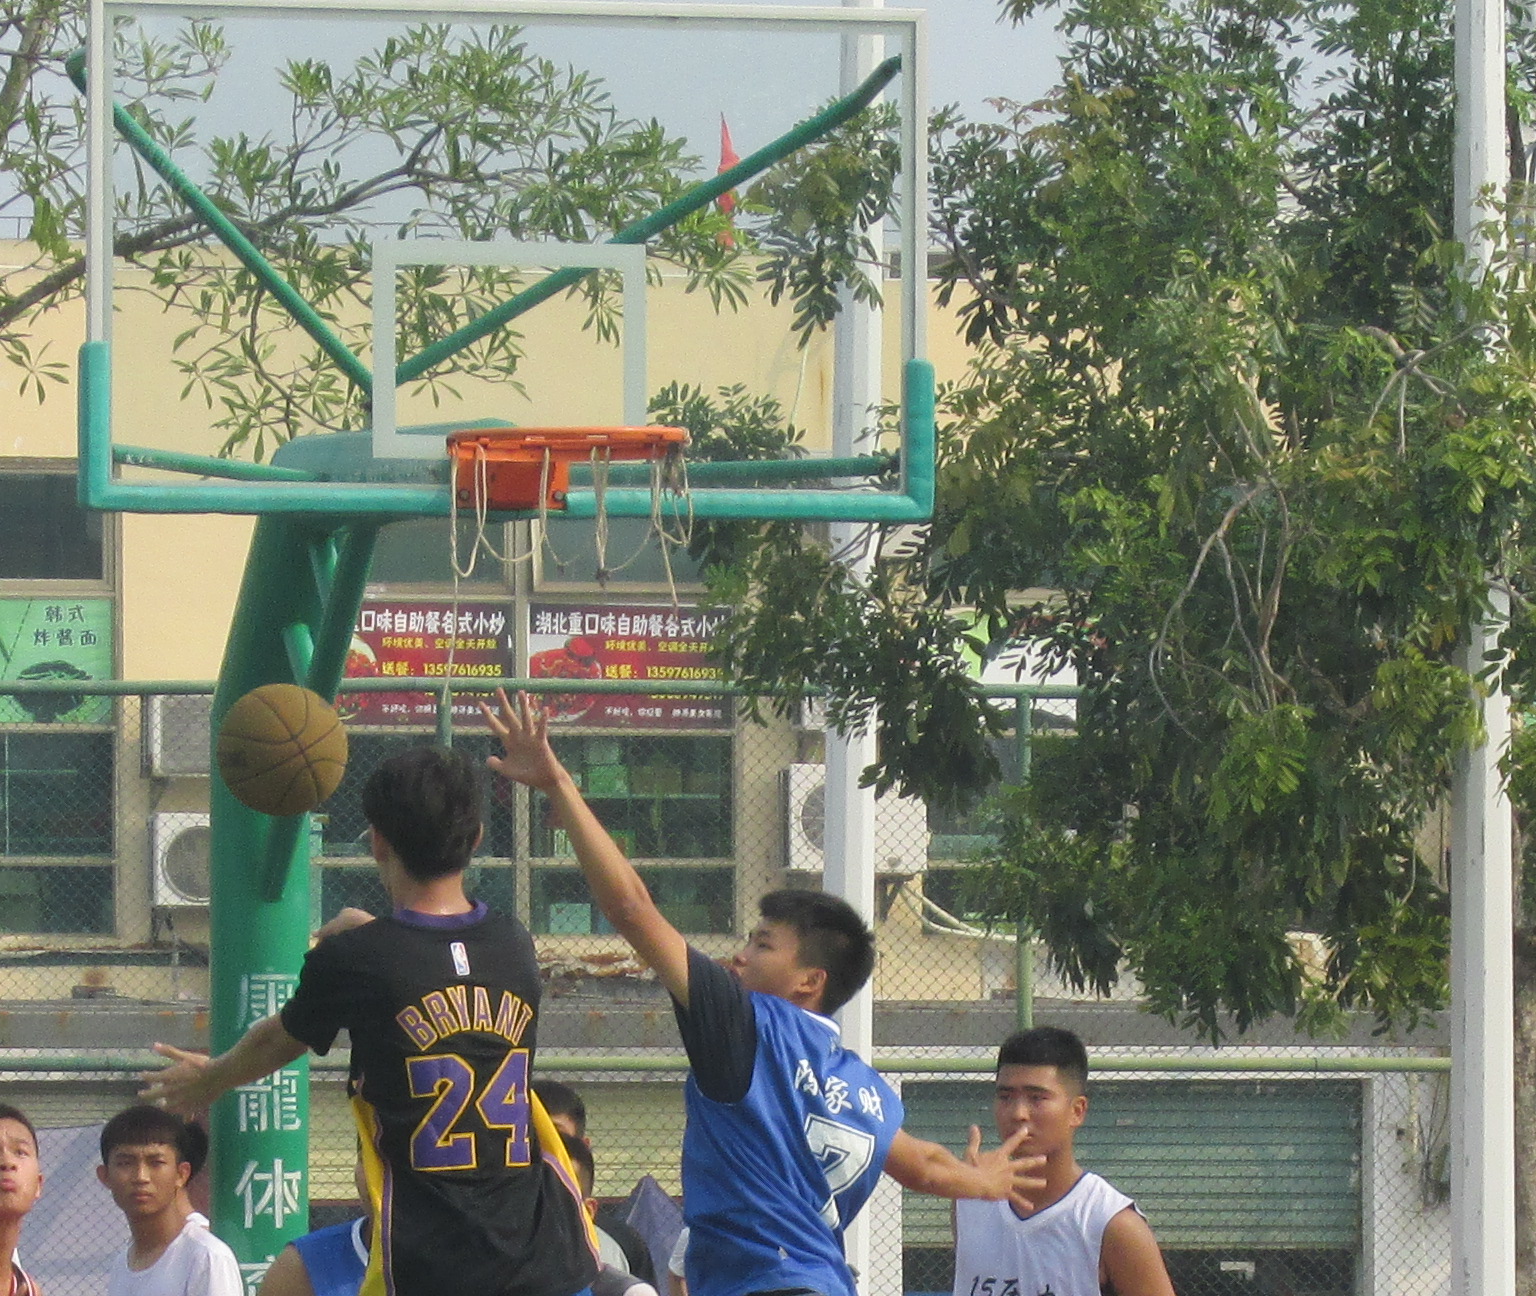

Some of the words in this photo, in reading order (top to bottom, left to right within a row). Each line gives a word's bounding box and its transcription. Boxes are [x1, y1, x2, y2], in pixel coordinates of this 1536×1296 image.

[44, 604, 86, 624] 韩式
[353, 610, 506, 636] 口味自助餐各式小炒
[33, 628, 97, 648] 炸酱面
[423, 663, 502, 677] 13597616935
[396, 985, 533, 1051] BRYANT
[405, 1048, 532, 1172] 24
